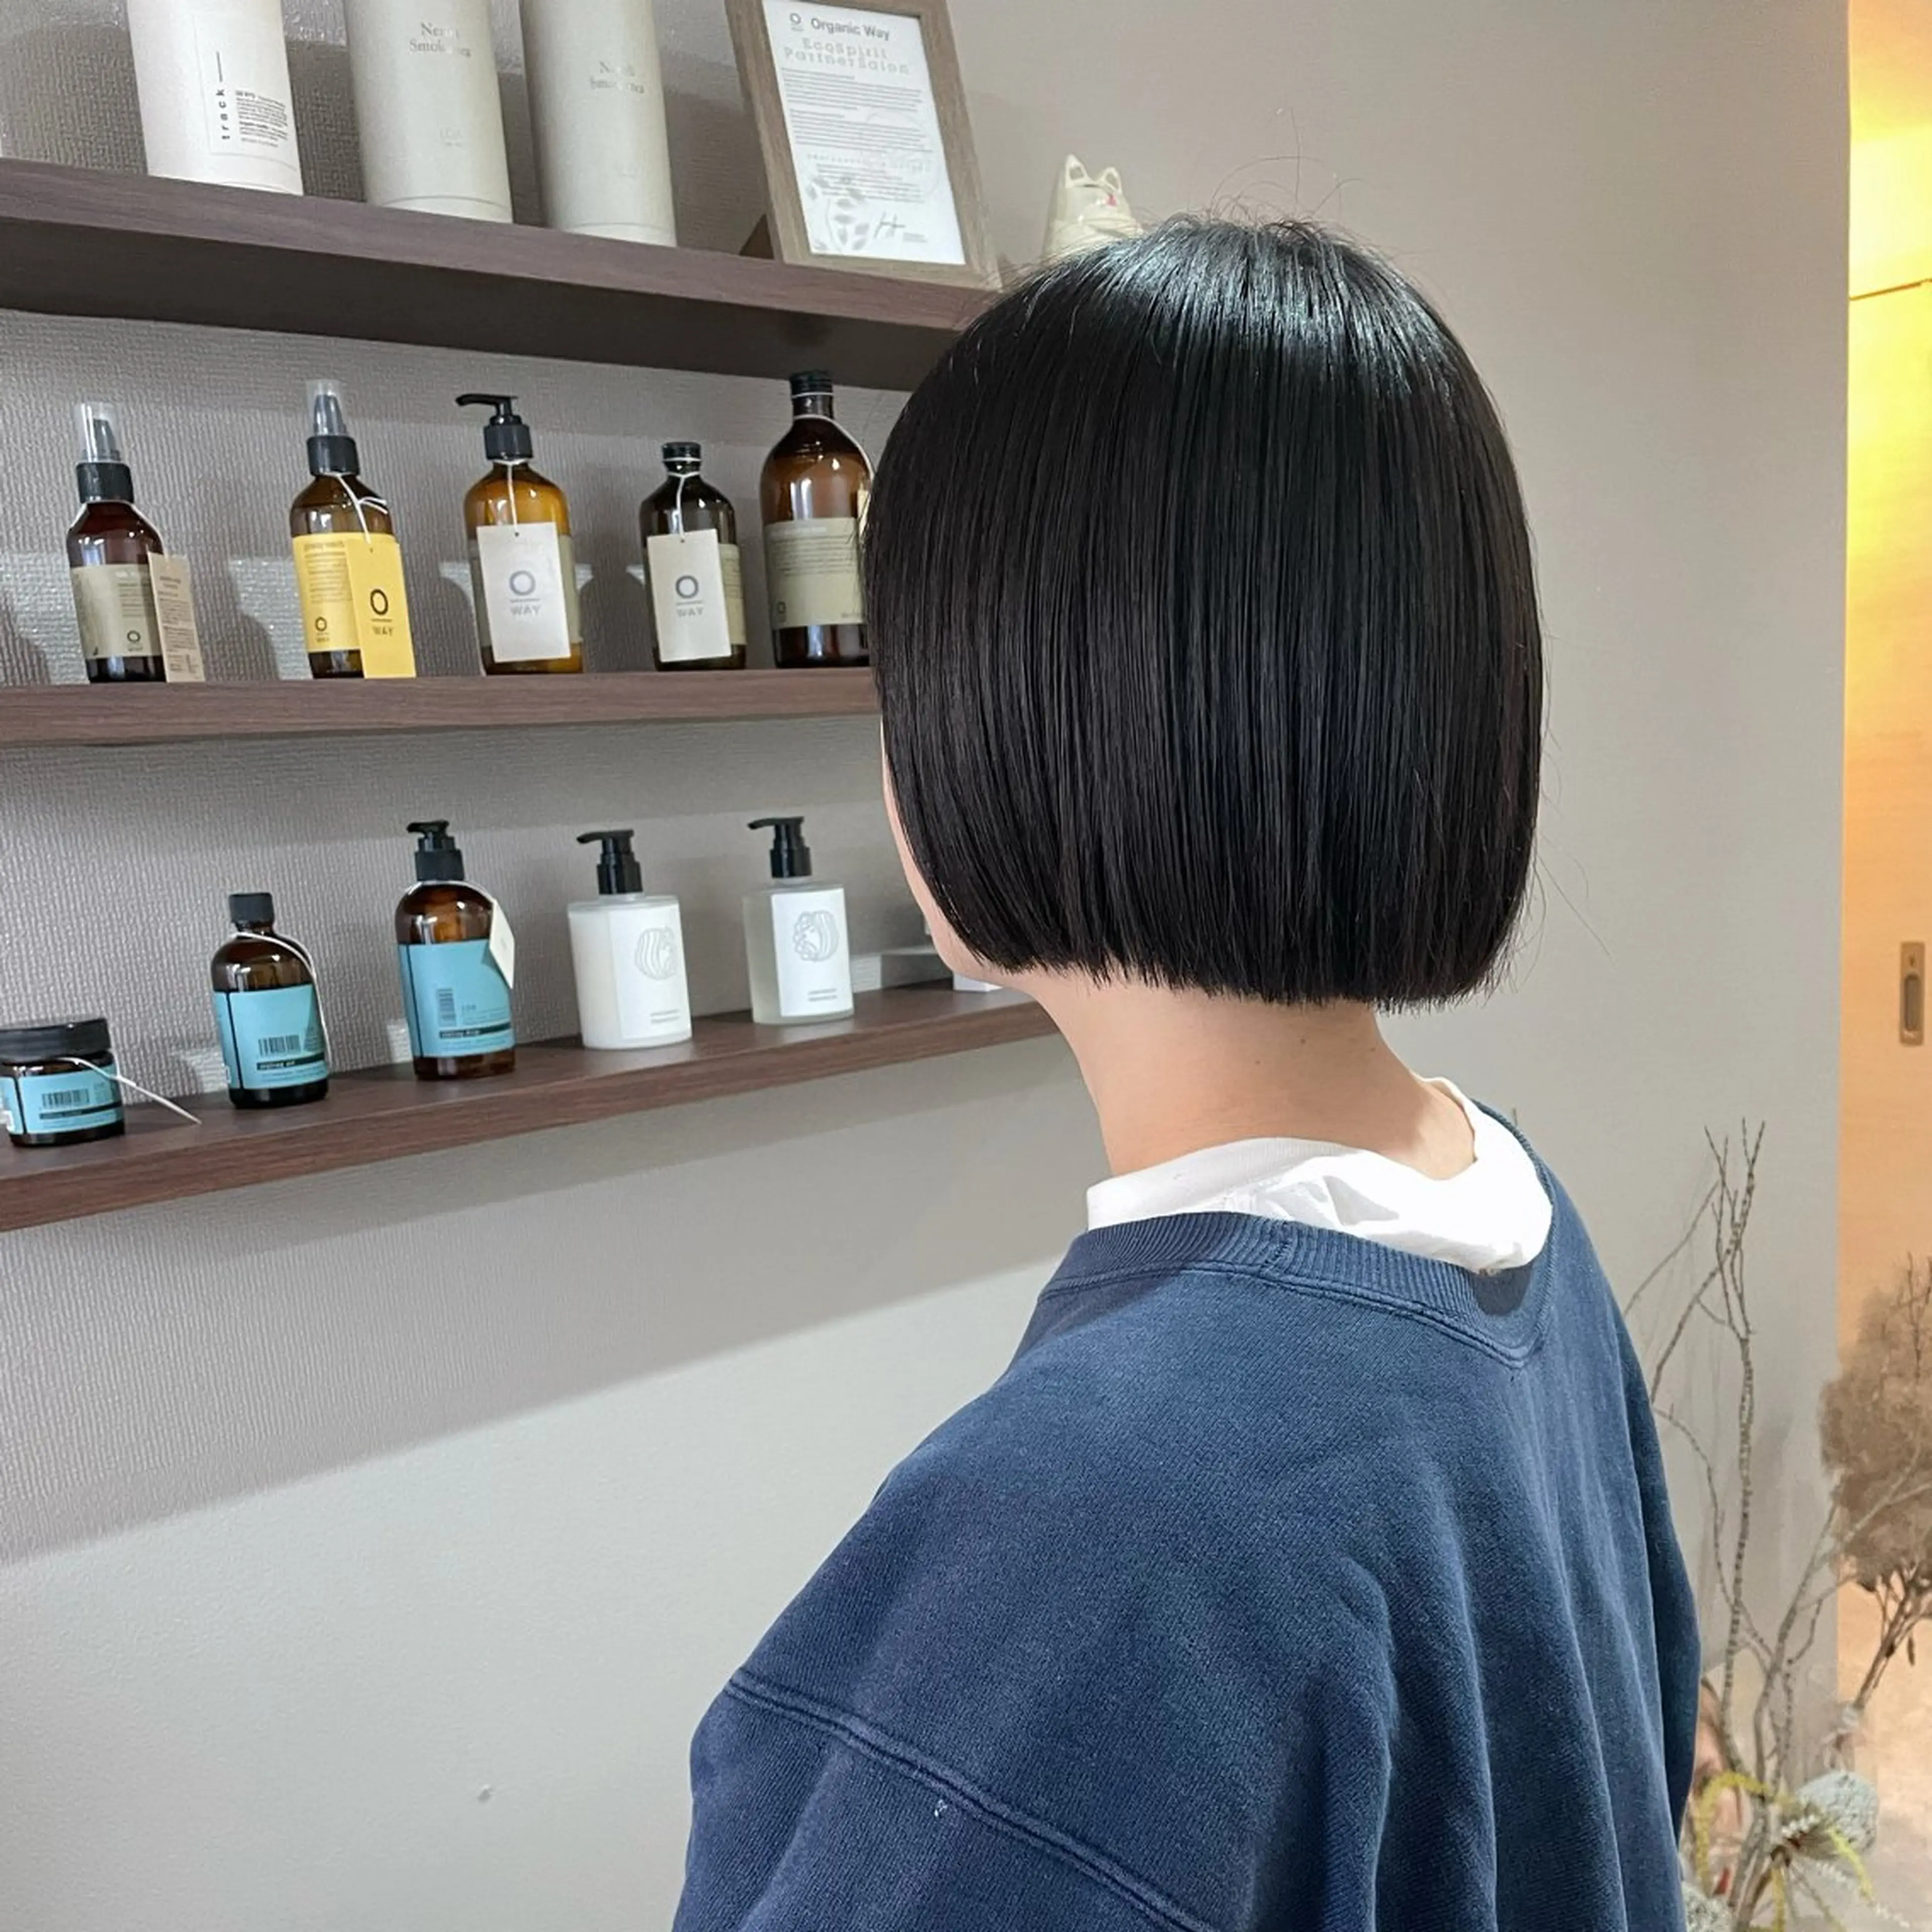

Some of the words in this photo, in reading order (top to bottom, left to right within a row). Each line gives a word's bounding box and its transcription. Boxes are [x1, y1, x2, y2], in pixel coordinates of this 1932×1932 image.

[811, 18, 861, 36] Organic
[862, 24, 890, 41] Way
[215, 89, 230, 140] track
[510, 604, 542, 615] WAY
[676, 607, 704, 618] WAY
[372, 625, 394, 637] WAY
